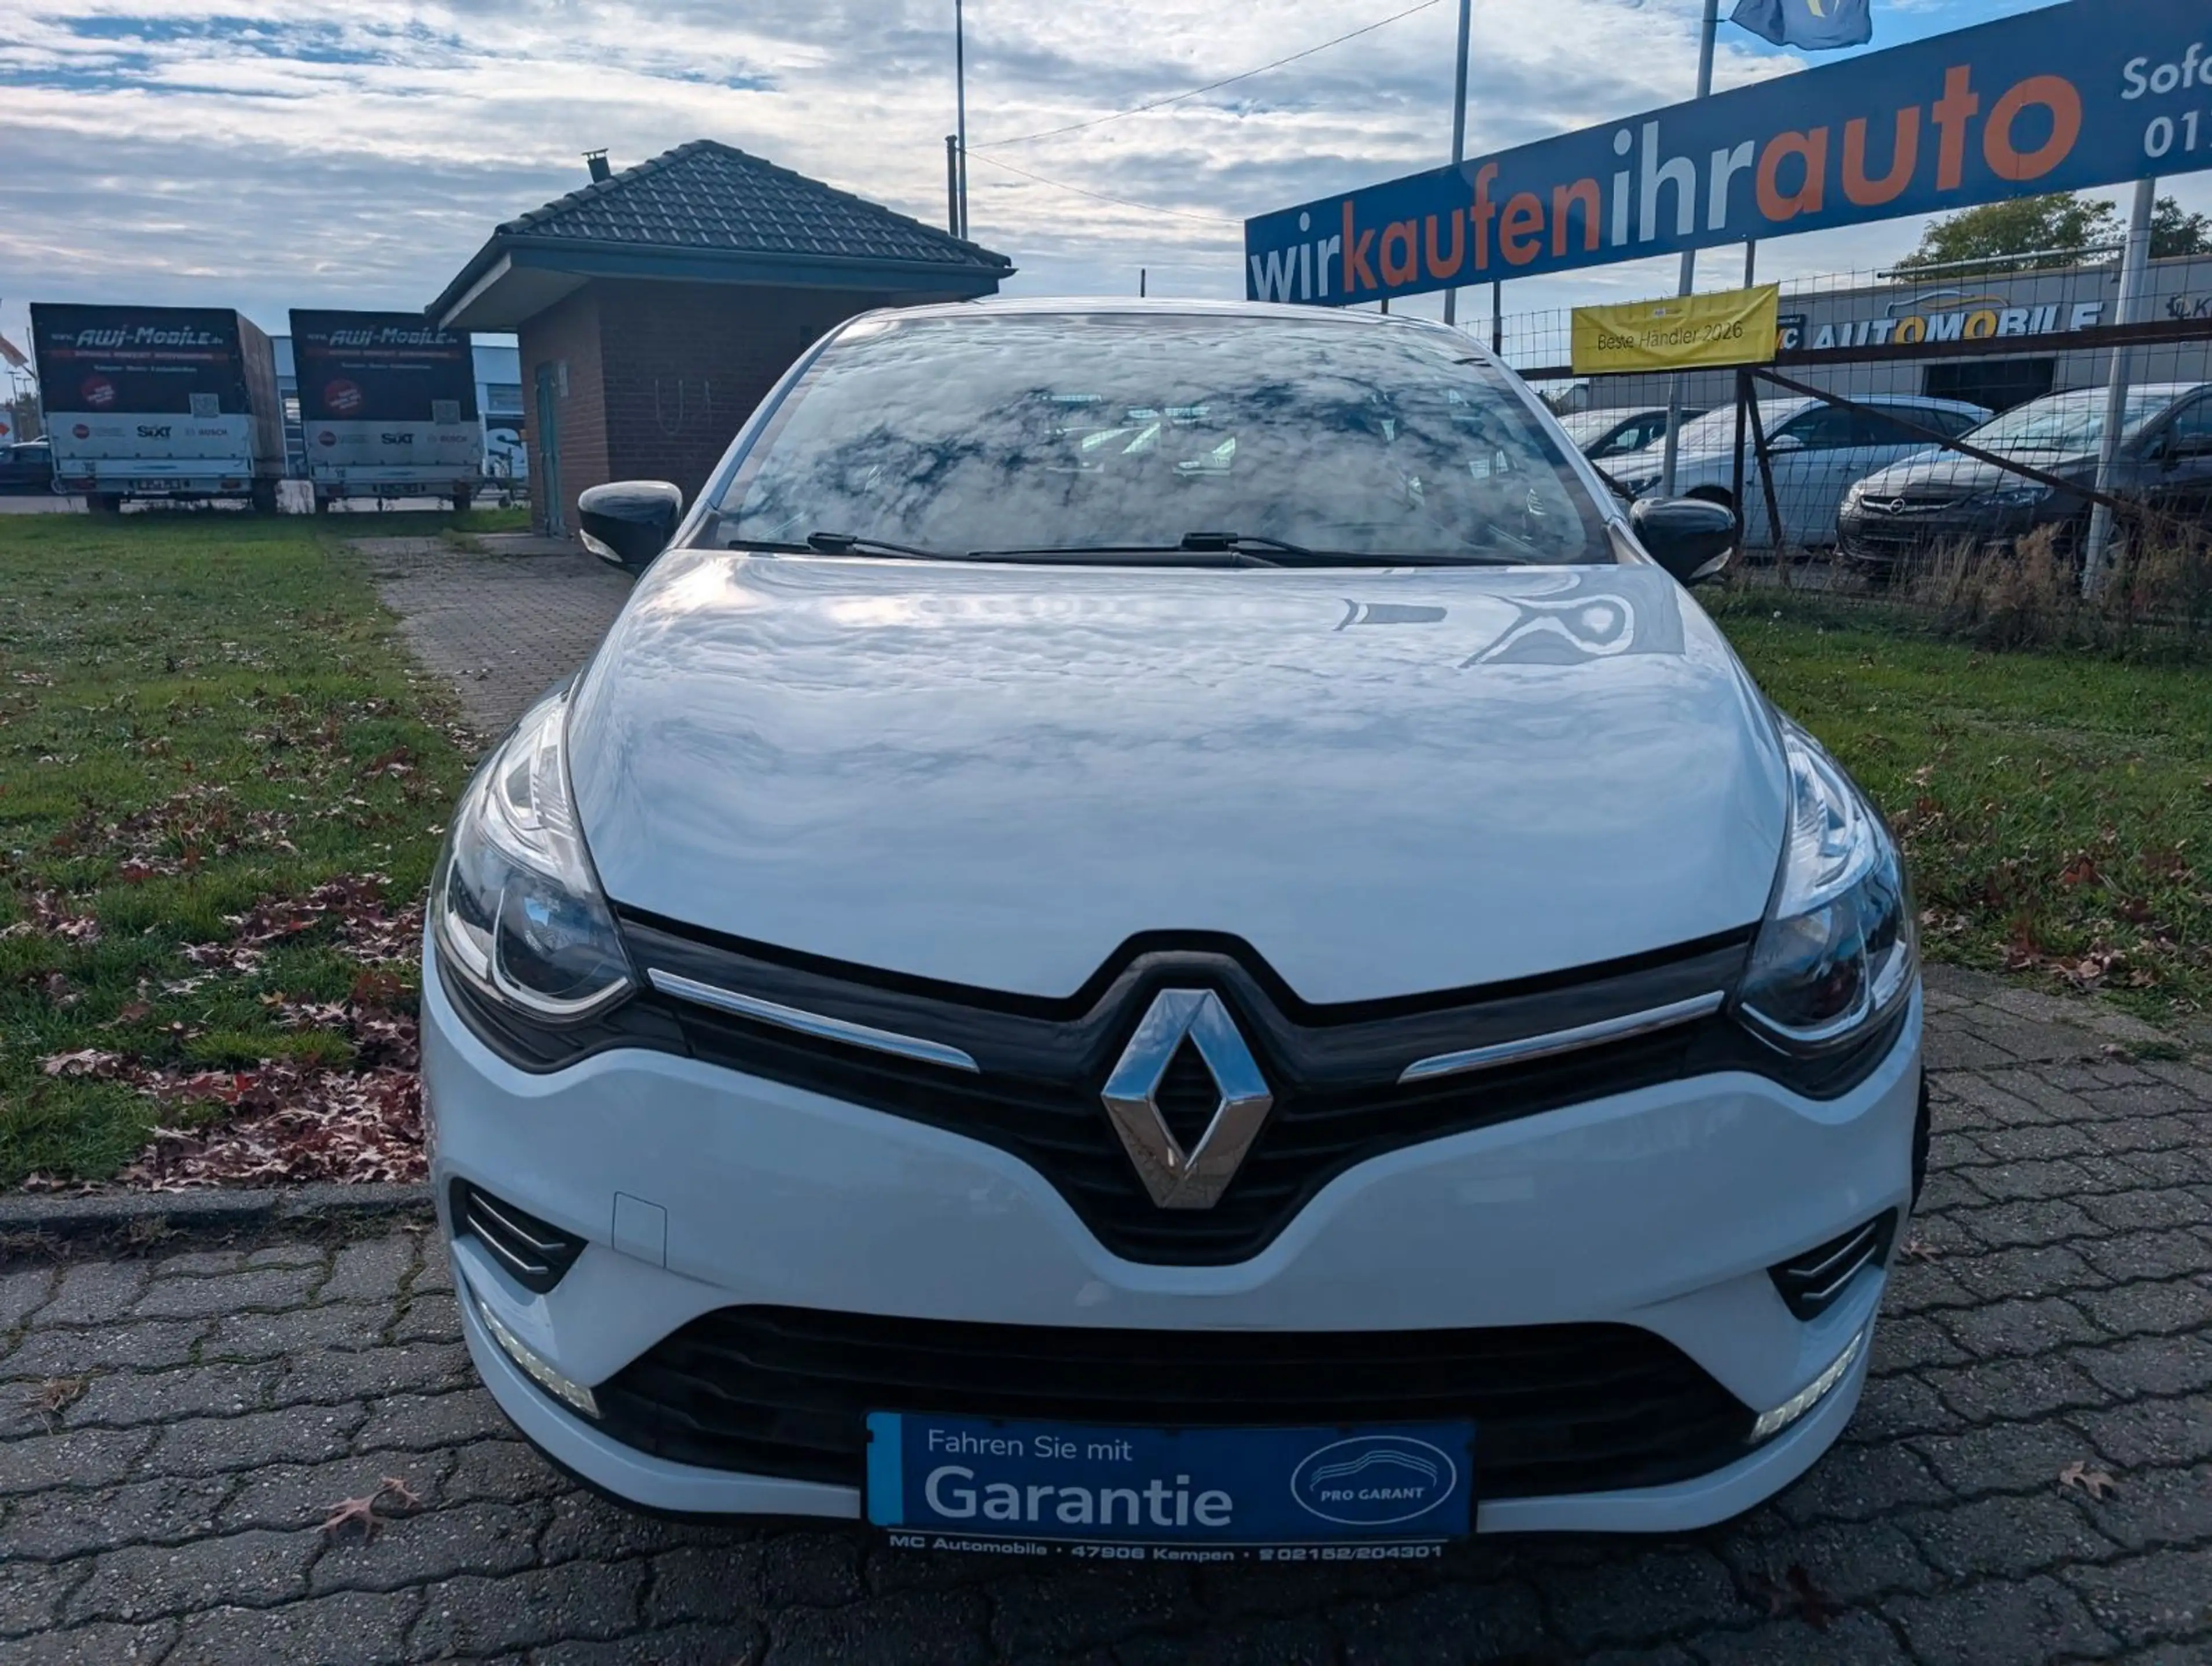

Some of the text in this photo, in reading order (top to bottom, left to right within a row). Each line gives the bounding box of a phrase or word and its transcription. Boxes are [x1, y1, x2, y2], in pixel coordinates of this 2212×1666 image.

[2144, 110, 2212, 158] 01
[1250, 62, 2082, 303] wirkaufenihrauto
[1598, 320, 1743, 351] Beste Händler 2026
[929, 1428, 1133, 1461] Fahren Sie mit
[925, 1465, 1234, 1527] Garantie
[1321, 1487, 1425, 1502] PRO GARANT
[889, 1535, 926, 1549] MC
[933, 1537, 1048, 1556] Automobile
[1153, 1547, 1235, 1564] Kempen
